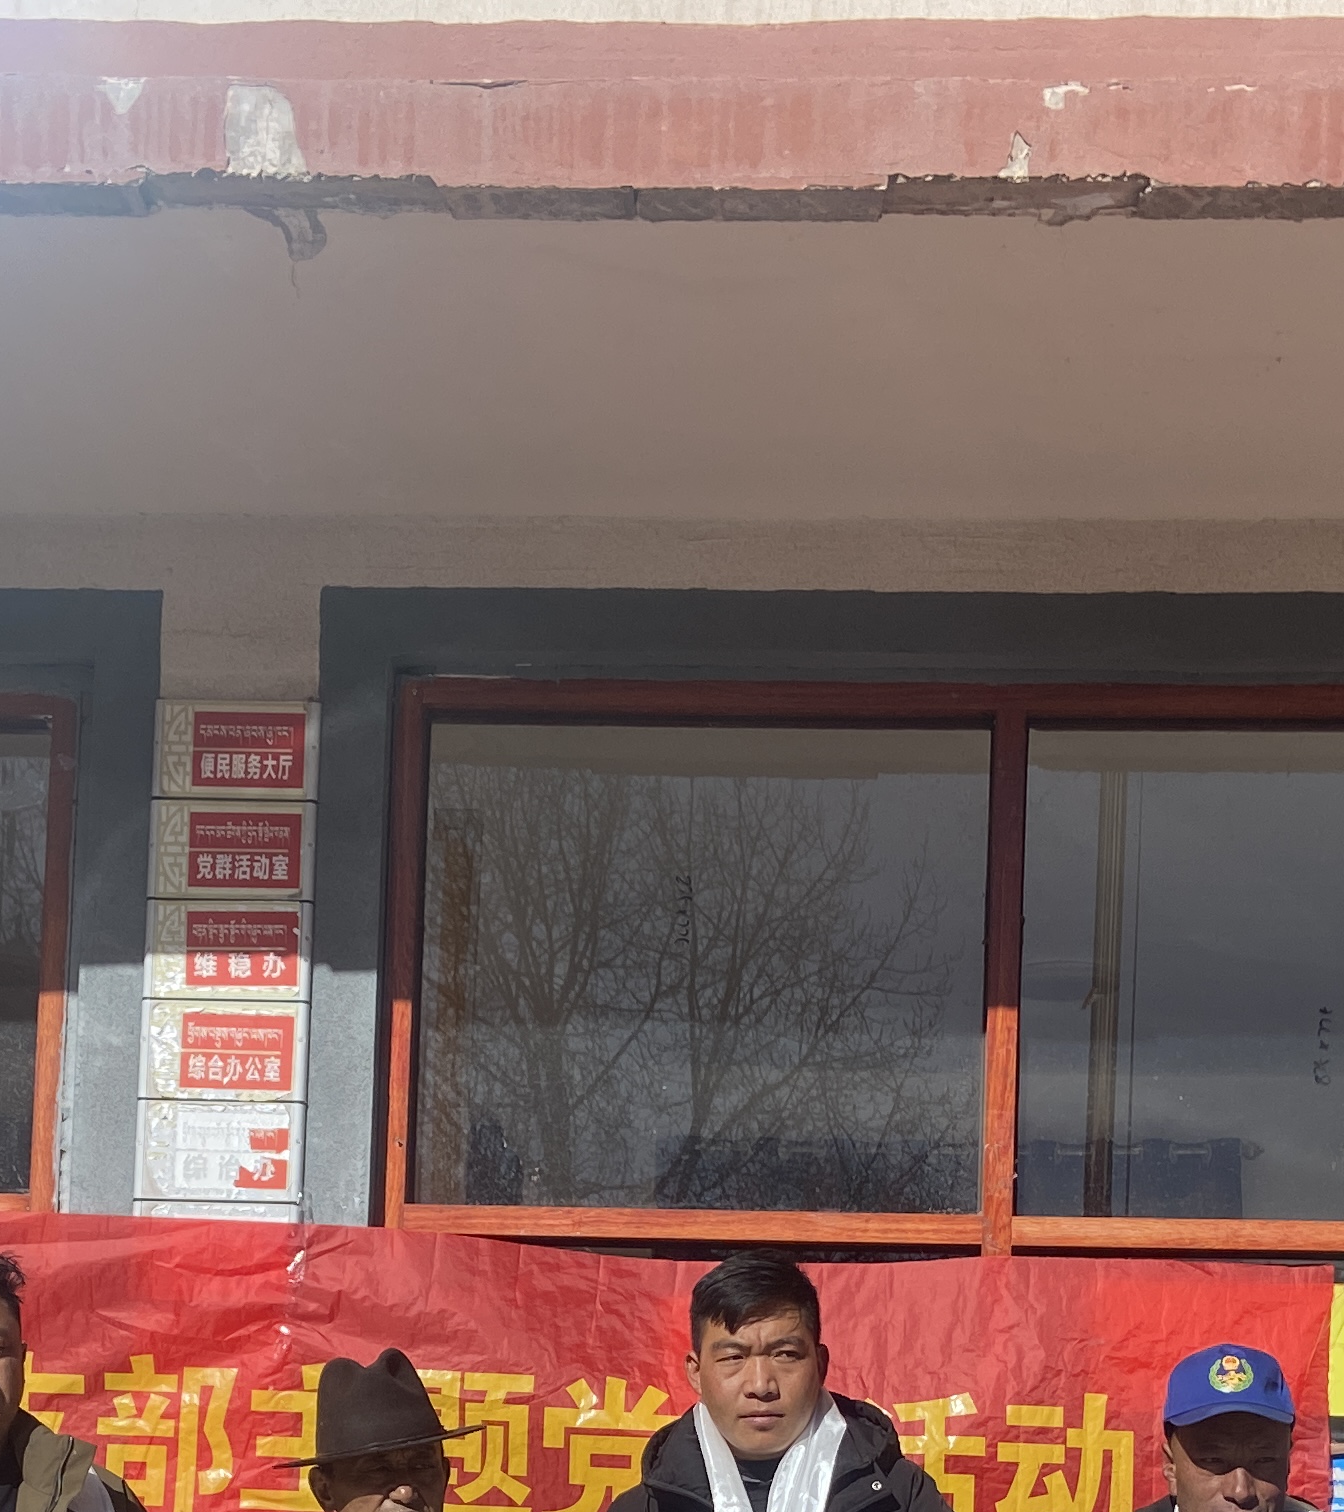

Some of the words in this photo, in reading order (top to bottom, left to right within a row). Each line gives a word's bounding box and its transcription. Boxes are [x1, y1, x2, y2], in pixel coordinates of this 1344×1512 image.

[201, 753, 293, 780] 便民服务大厅
[196, 853, 289, 880] 党群活动室
[193, 952, 286, 978] 维稳办
[187, 1054, 281, 1085] 综合办公室
